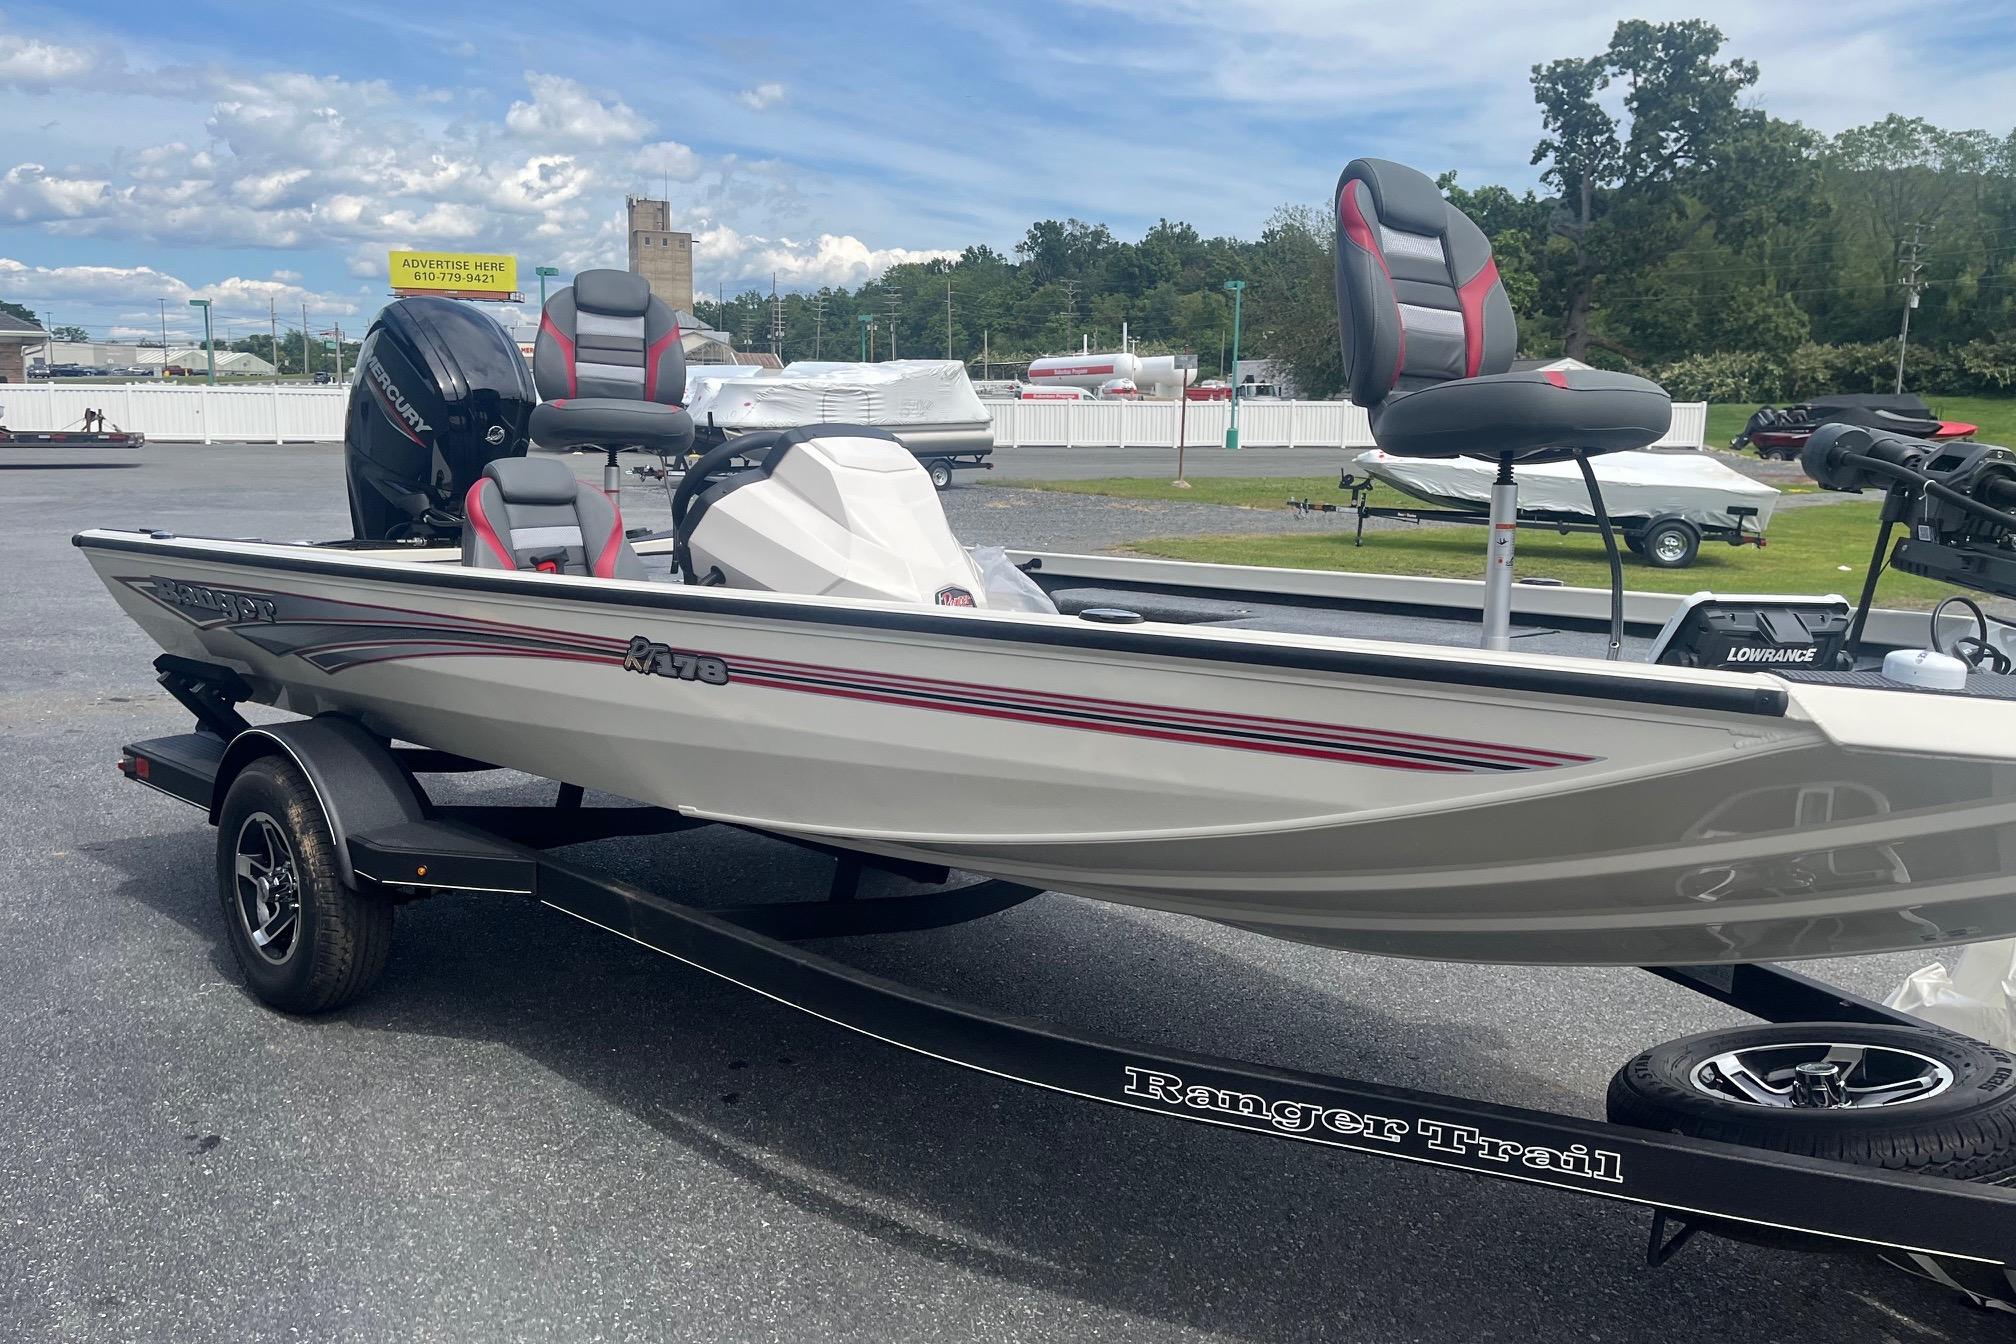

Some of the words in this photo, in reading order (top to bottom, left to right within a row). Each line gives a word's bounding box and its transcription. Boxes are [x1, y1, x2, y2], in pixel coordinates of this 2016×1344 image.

[402, 258, 470, 271] ADVERTISE
[474, 261, 506, 272] HERE
[414, 271, 495, 284] 610-779-9421
[366, 354, 433, 433] MERCURY
[151, 575, 279, 623] Ranger
[1726, 647, 1818, 662] LOWRANCE
[1124, 1065, 1409, 1142] Ranger
[1418, 1118, 1625, 1184] Trail
